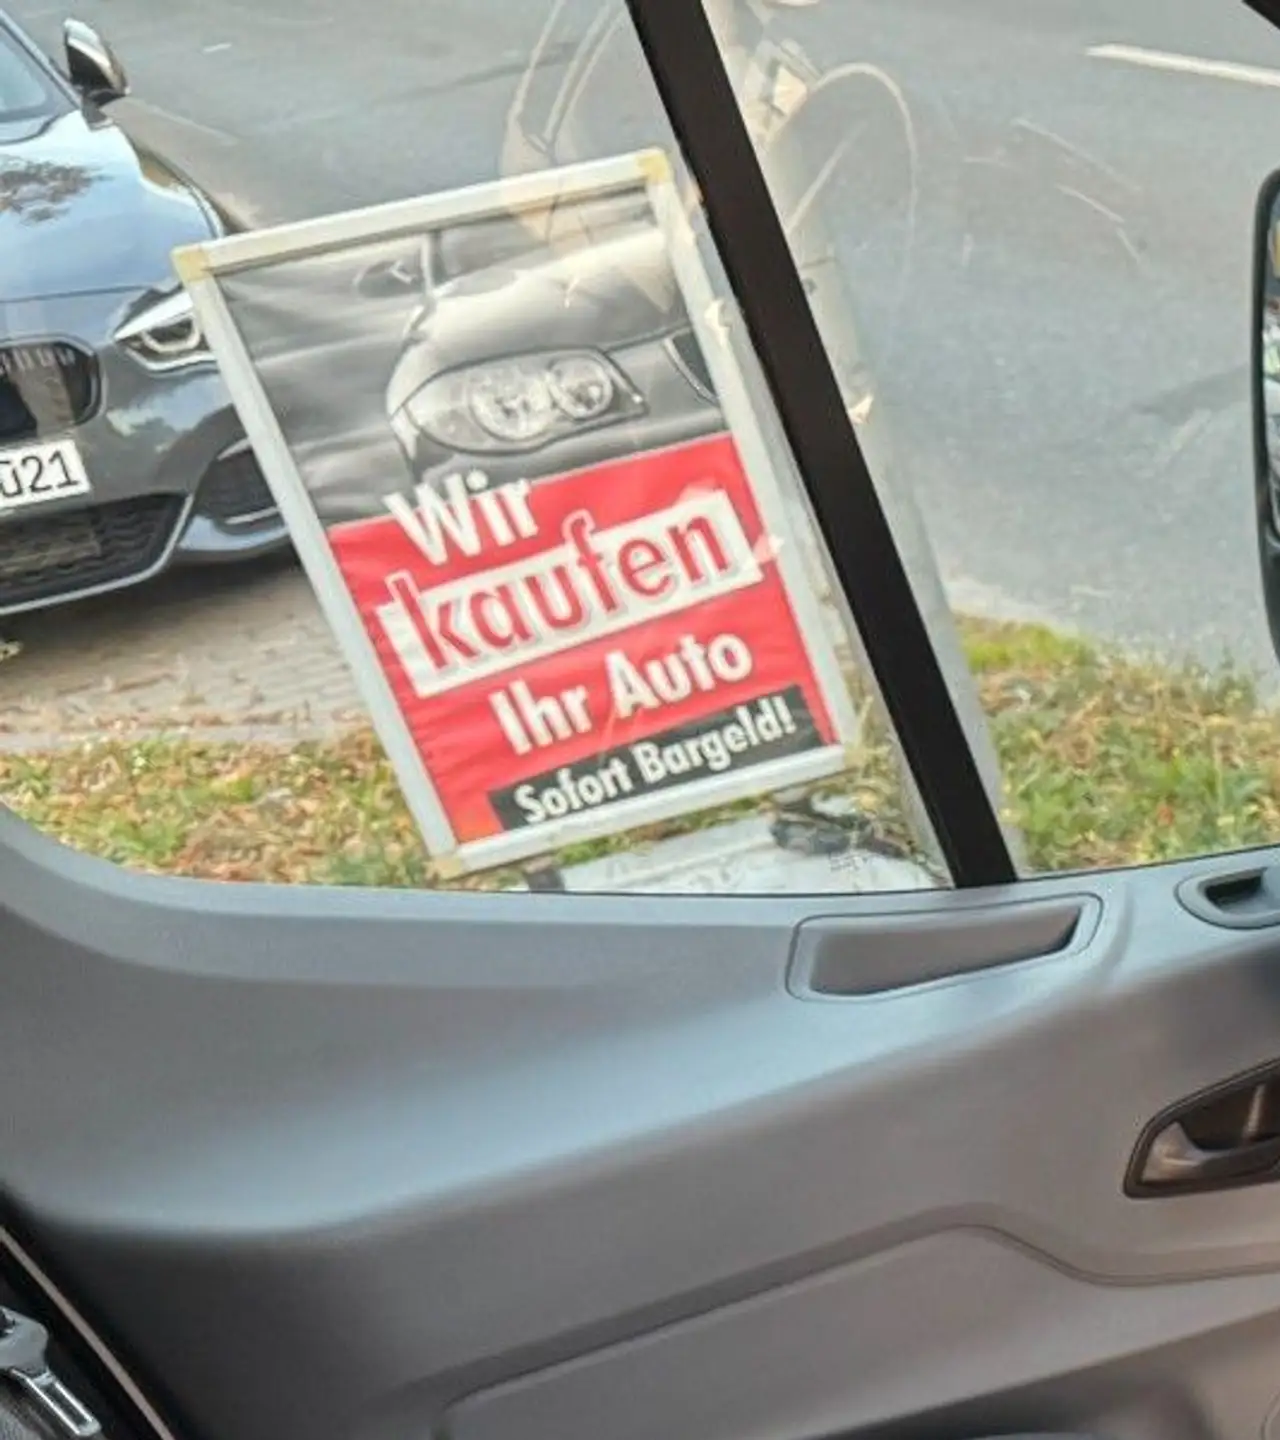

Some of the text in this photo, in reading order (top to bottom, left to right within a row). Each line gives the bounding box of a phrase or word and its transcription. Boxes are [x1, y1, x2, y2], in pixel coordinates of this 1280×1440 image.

[383, 470, 538, 566] Wir
[388, 512, 733, 669] kaufen
[490, 633, 753, 756] Ihr Auto
[514, 697, 796, 824] Sofort Bargeld!
